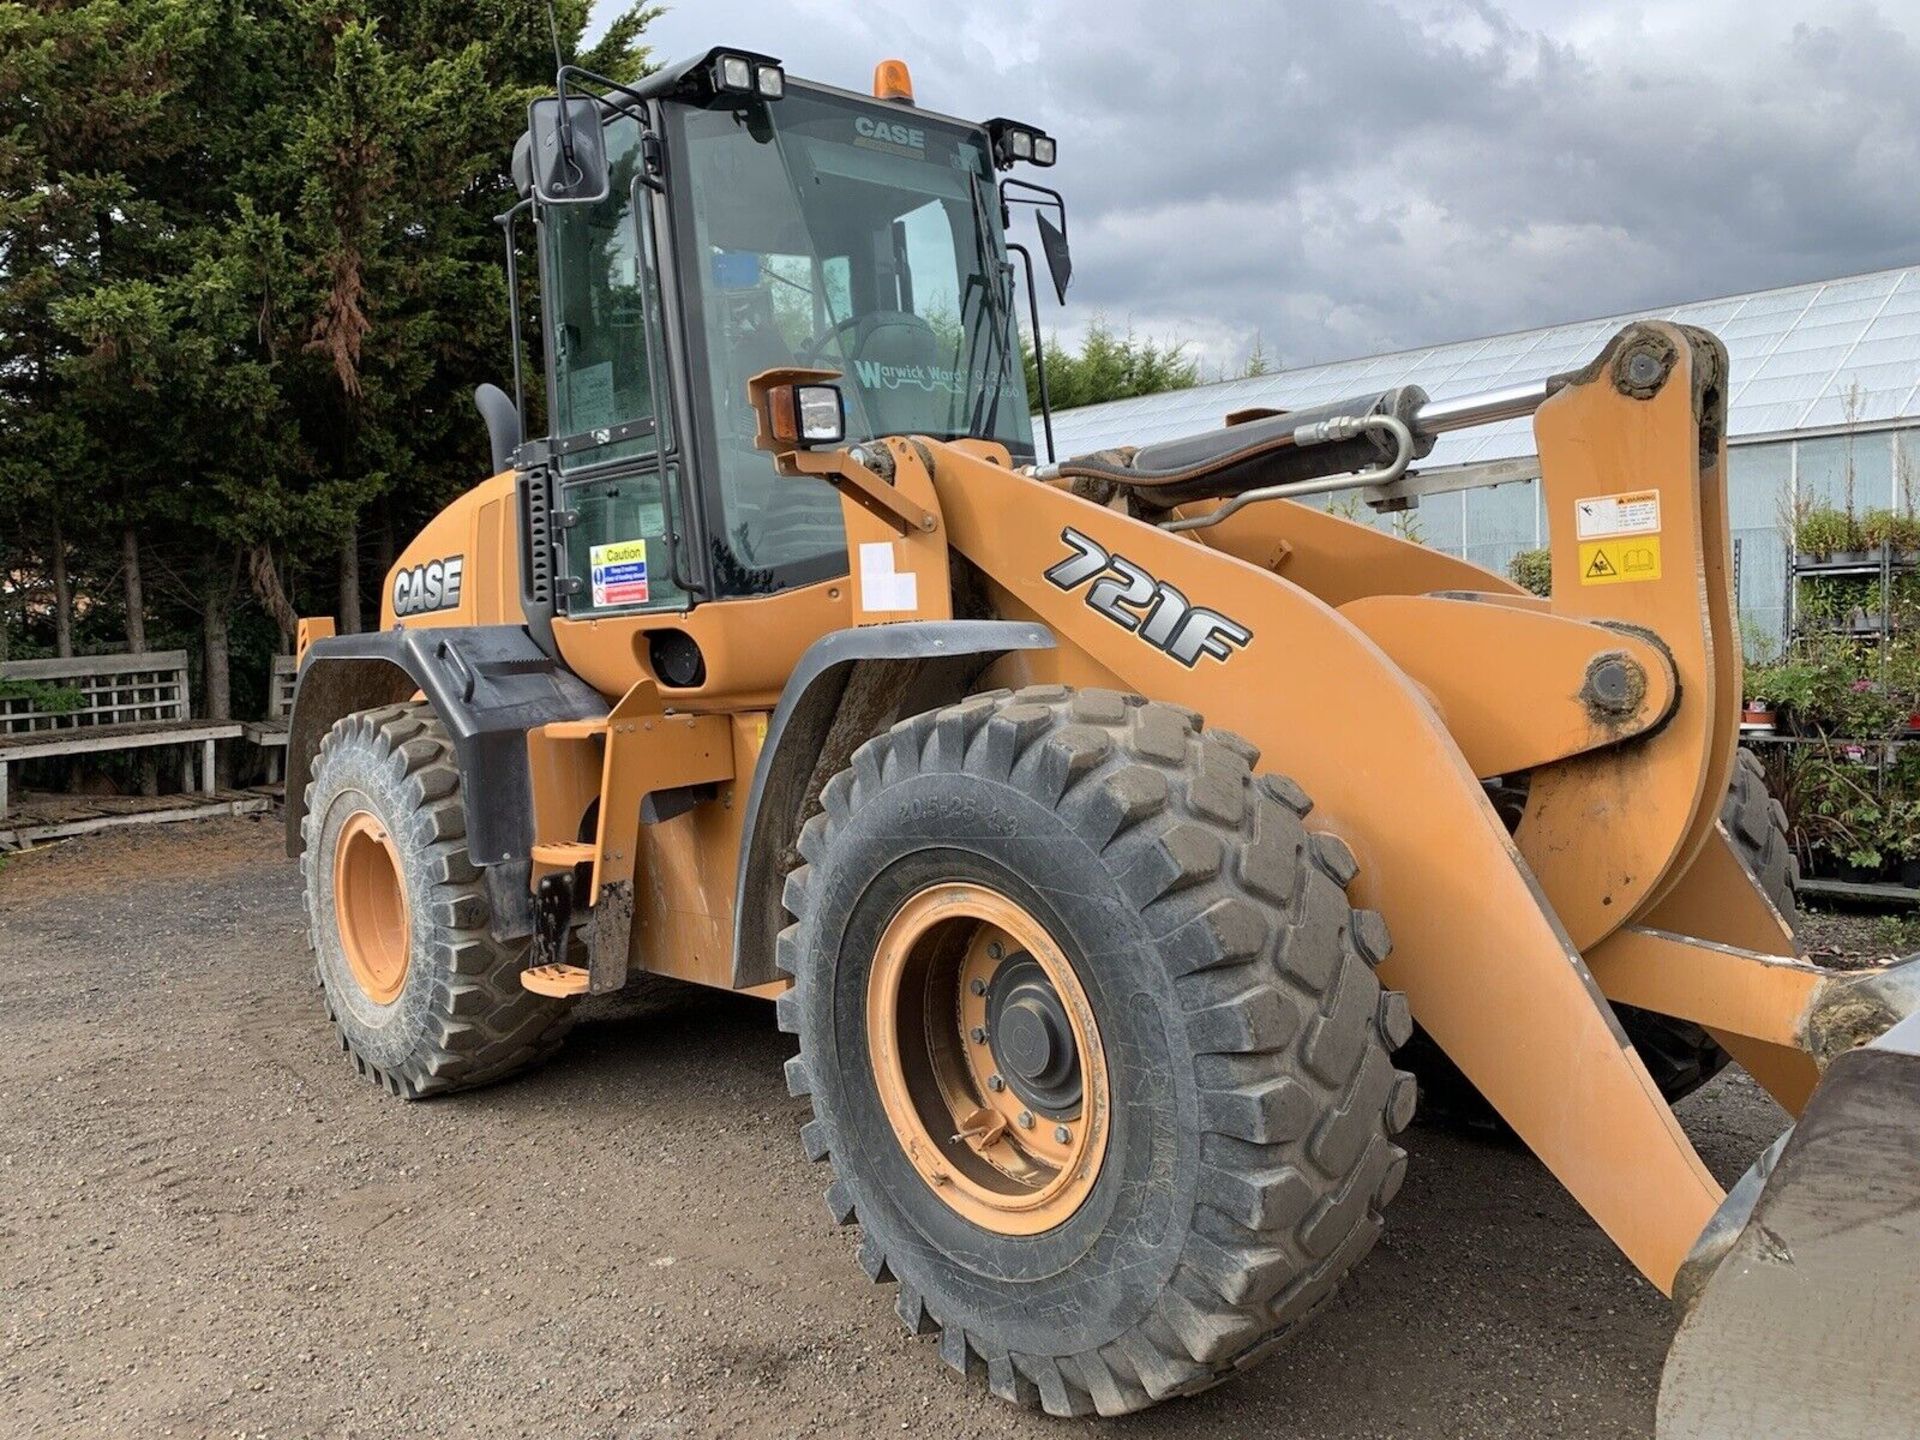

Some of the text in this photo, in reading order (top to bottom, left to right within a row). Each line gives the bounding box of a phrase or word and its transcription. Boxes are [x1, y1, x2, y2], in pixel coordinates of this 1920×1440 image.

[855, 116, 926, 149] CASE
[853, 360, 924, 389] Warwick
[927, 366, 962, 382] Ward
[606, 546, 641, 562] Caution
[393, 553, 464, 617] CASE
[1043, 525, 1254, 671] 721F
